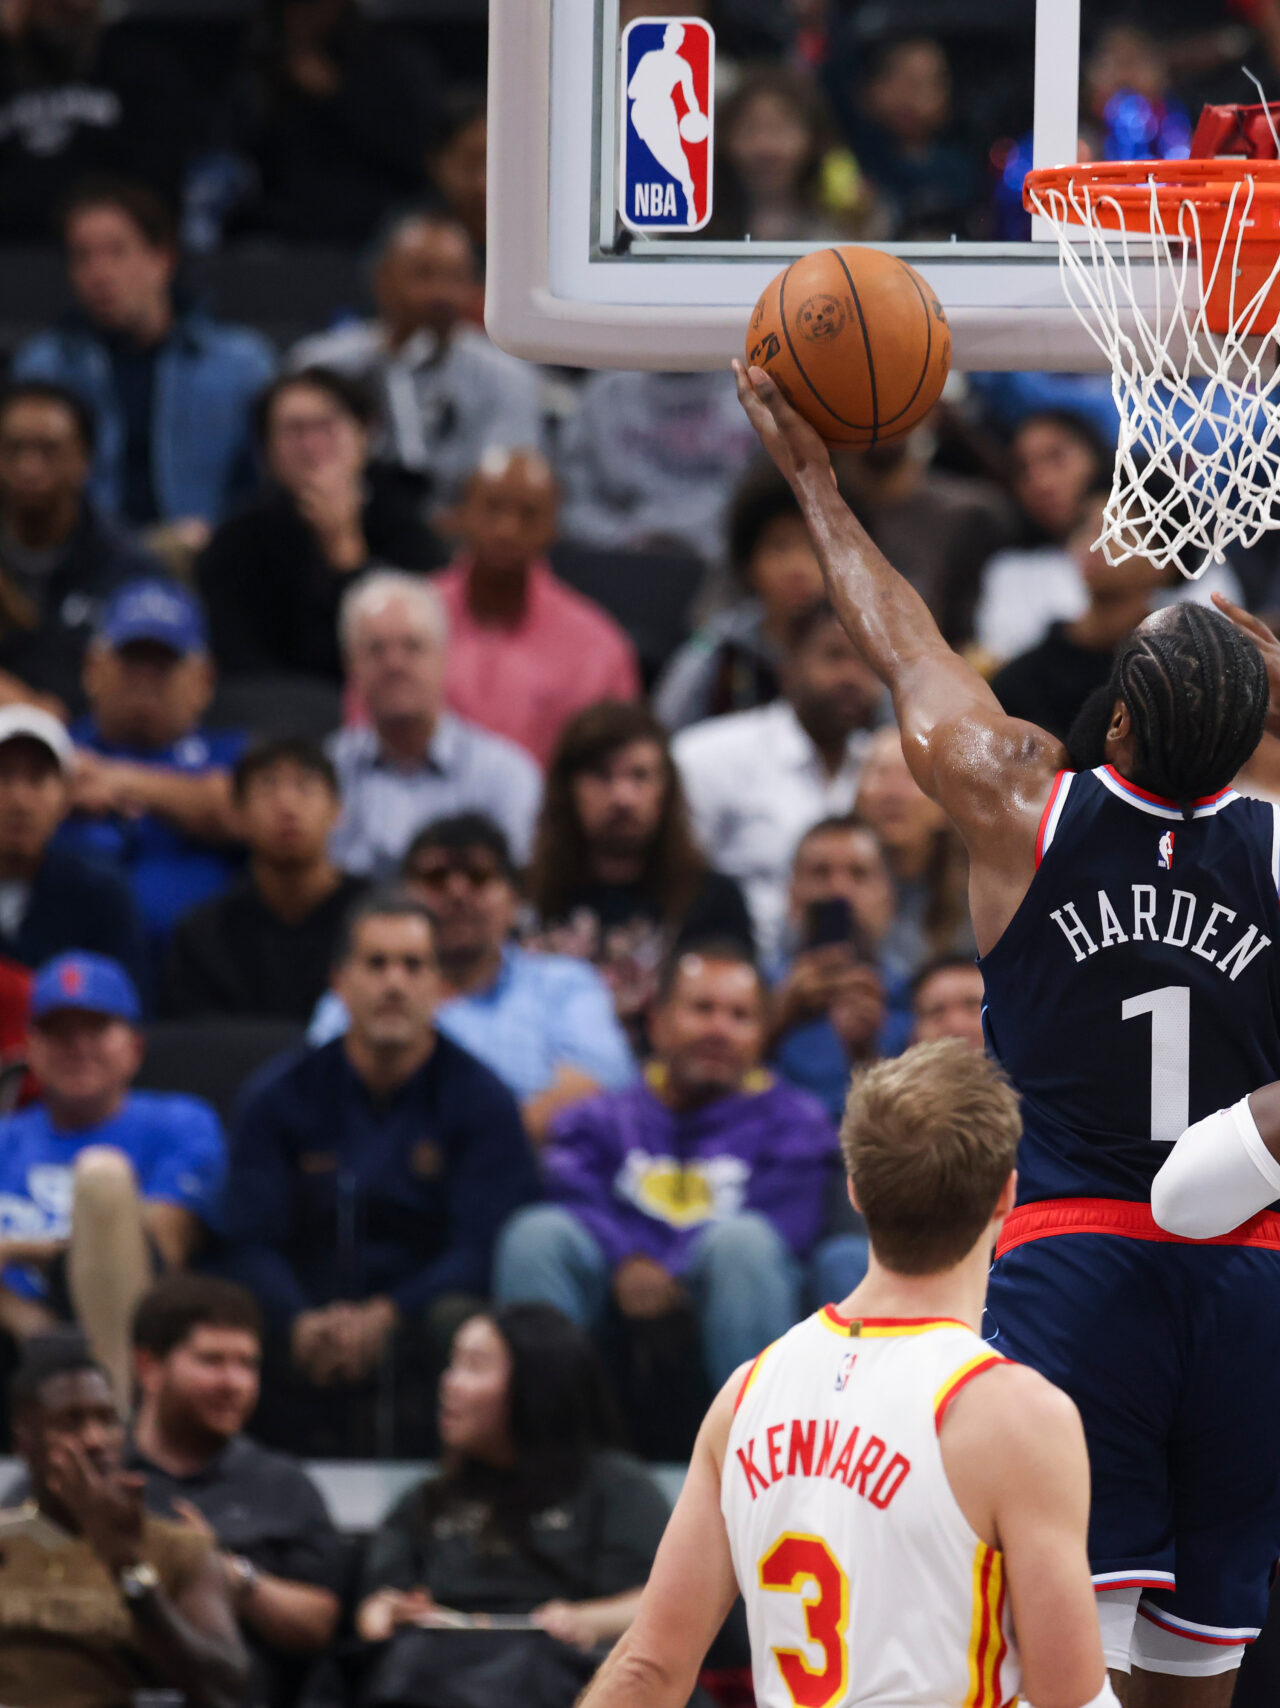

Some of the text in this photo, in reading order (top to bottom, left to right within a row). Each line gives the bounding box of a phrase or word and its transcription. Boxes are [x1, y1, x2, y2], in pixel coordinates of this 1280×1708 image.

[634, 183, 678, 217] NBA
[1049, 884, 1272, 982] HARDEN
[1121, 985, 1191, 1142] 1
[736, 1419, 912, 1511] KENNARD
[757, 1530, 850, 1708] 3
